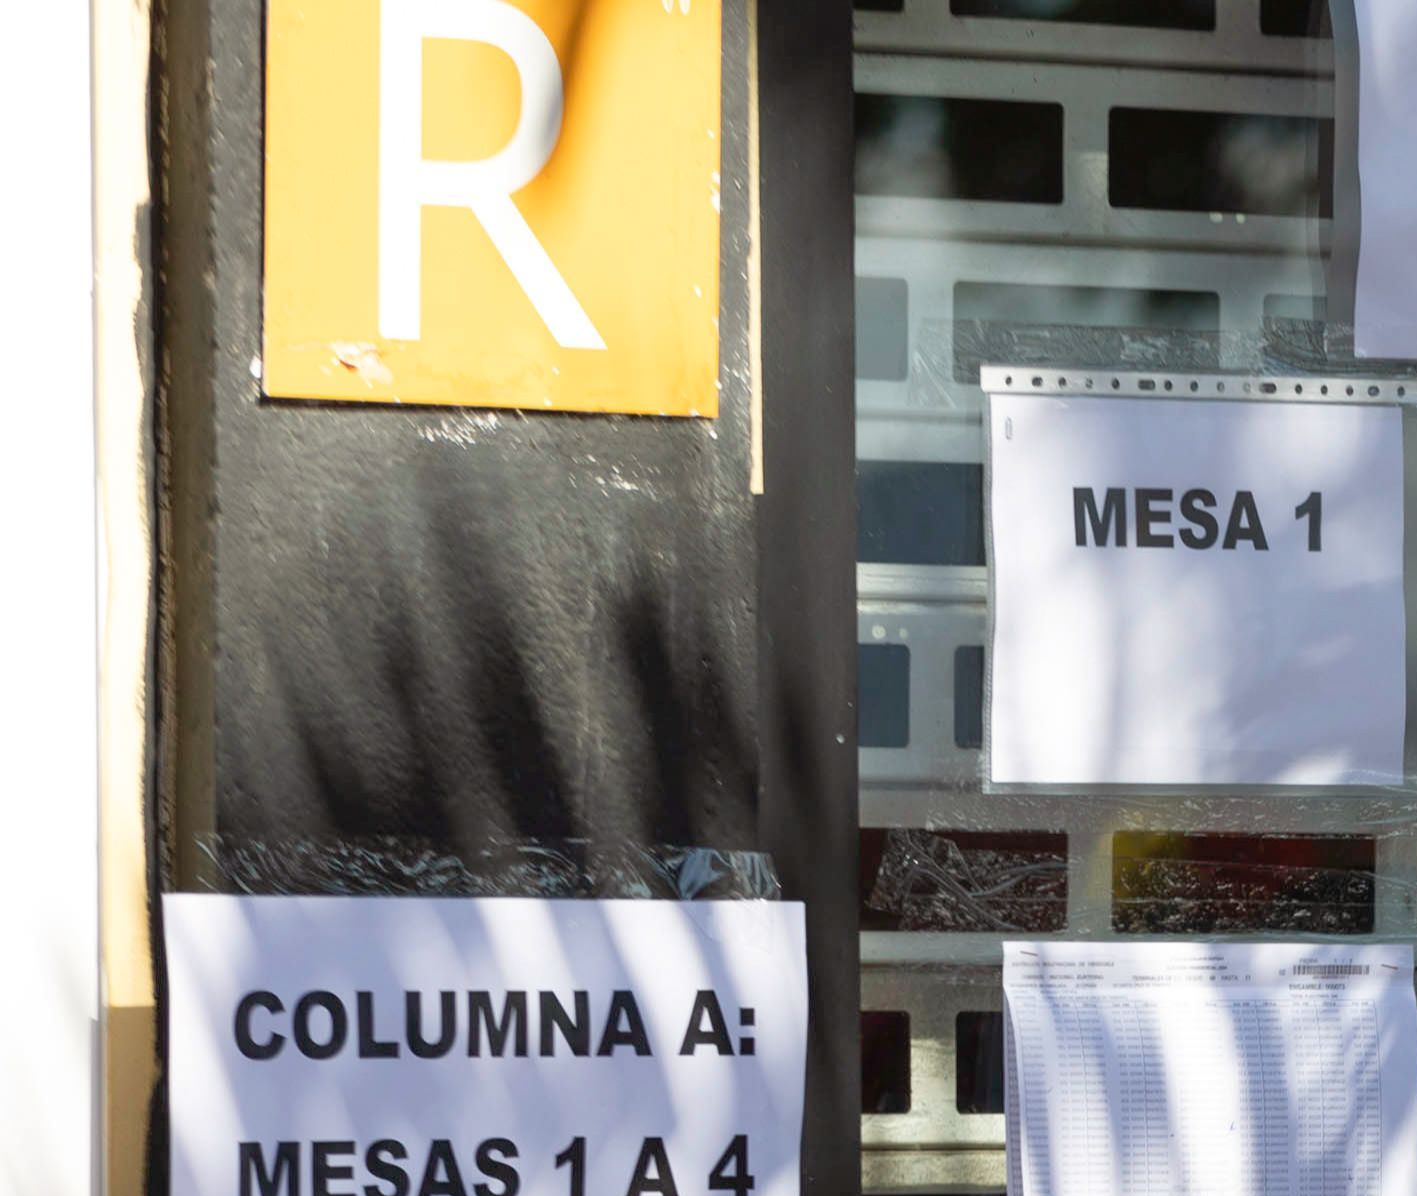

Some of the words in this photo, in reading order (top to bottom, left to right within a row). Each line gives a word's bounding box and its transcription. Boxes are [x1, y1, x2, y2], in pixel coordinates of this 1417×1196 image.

[378, 0, 607, 350] R
[1072, 487, 1270, 551] MESA
[1294, 491, 1323, 552] 1
[232, 988, 654, 1062] COLUMNA
[678, 988, 757, 1058] A:
